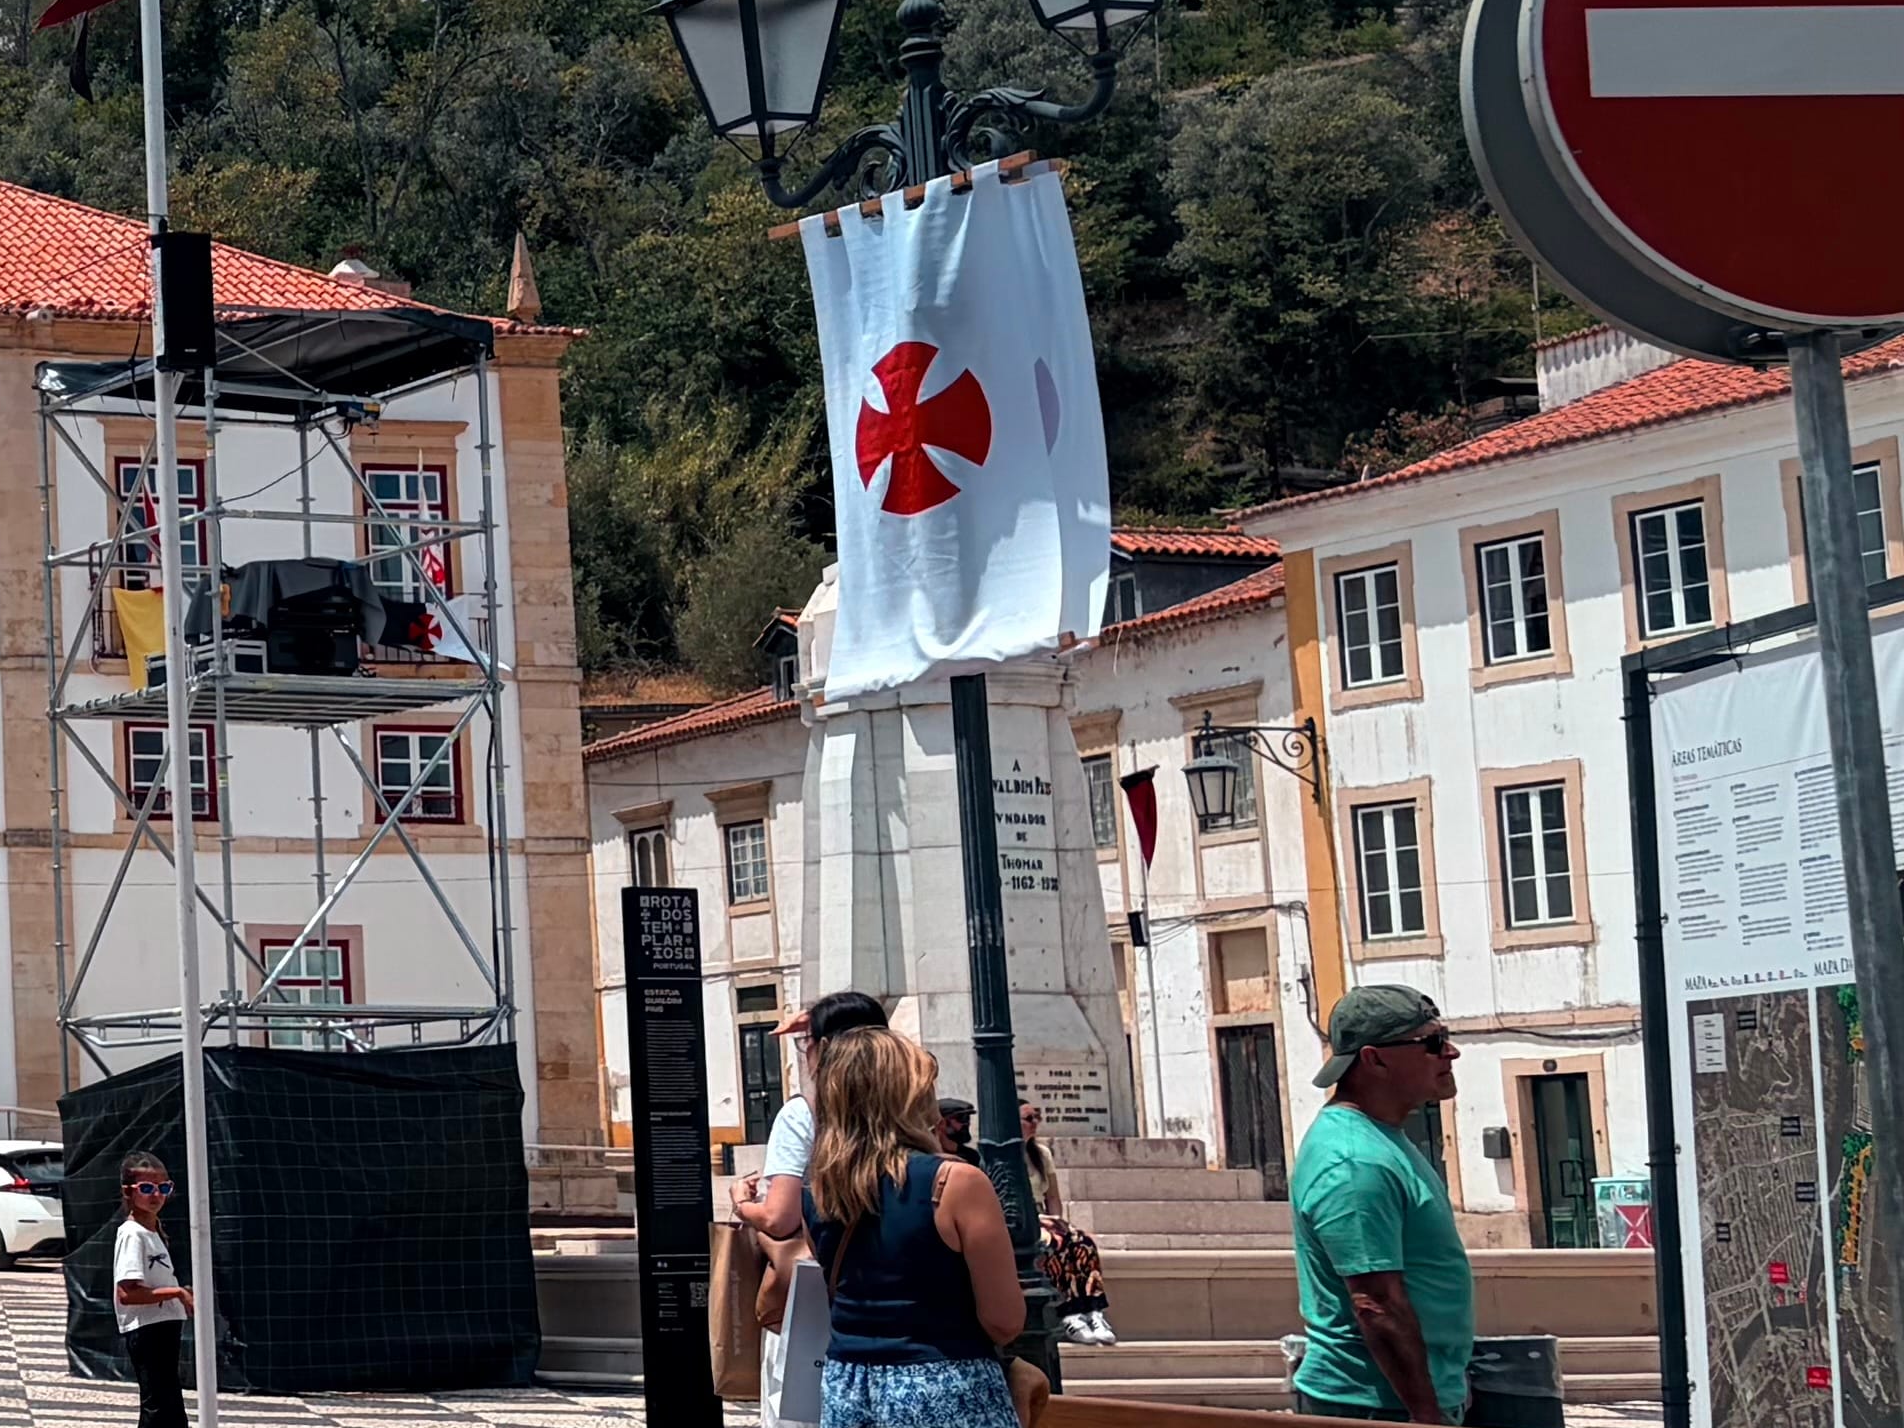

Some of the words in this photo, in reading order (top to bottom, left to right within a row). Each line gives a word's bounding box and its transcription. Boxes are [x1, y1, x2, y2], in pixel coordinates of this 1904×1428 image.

[1672, 748, 1695, 767] ÁREAS
[1697, 737, 1742, 762] TEMÁTICAS
[1012, 759, 1021, 772] A
[992, 779, 1033, 794] VALDIM
[995, 813, 1046, 826] VNDADOR
[1016, 832, 1027, 842] DE
[1000, 854, 1043, 871] THOMAR
[651, 895, 692, 908] ROTA
[661, 909, 692, 921] DOS
[641, 921, 672, 933] TEM
[641, 934, 683, 946] PLAR
[653, 947, 684, 959] IOS
[653, 962, 695, 970] PORTUGAL
[1813, 959, 1839, 976] MAPA
[1685, 975, 1707, 991] MAPA
